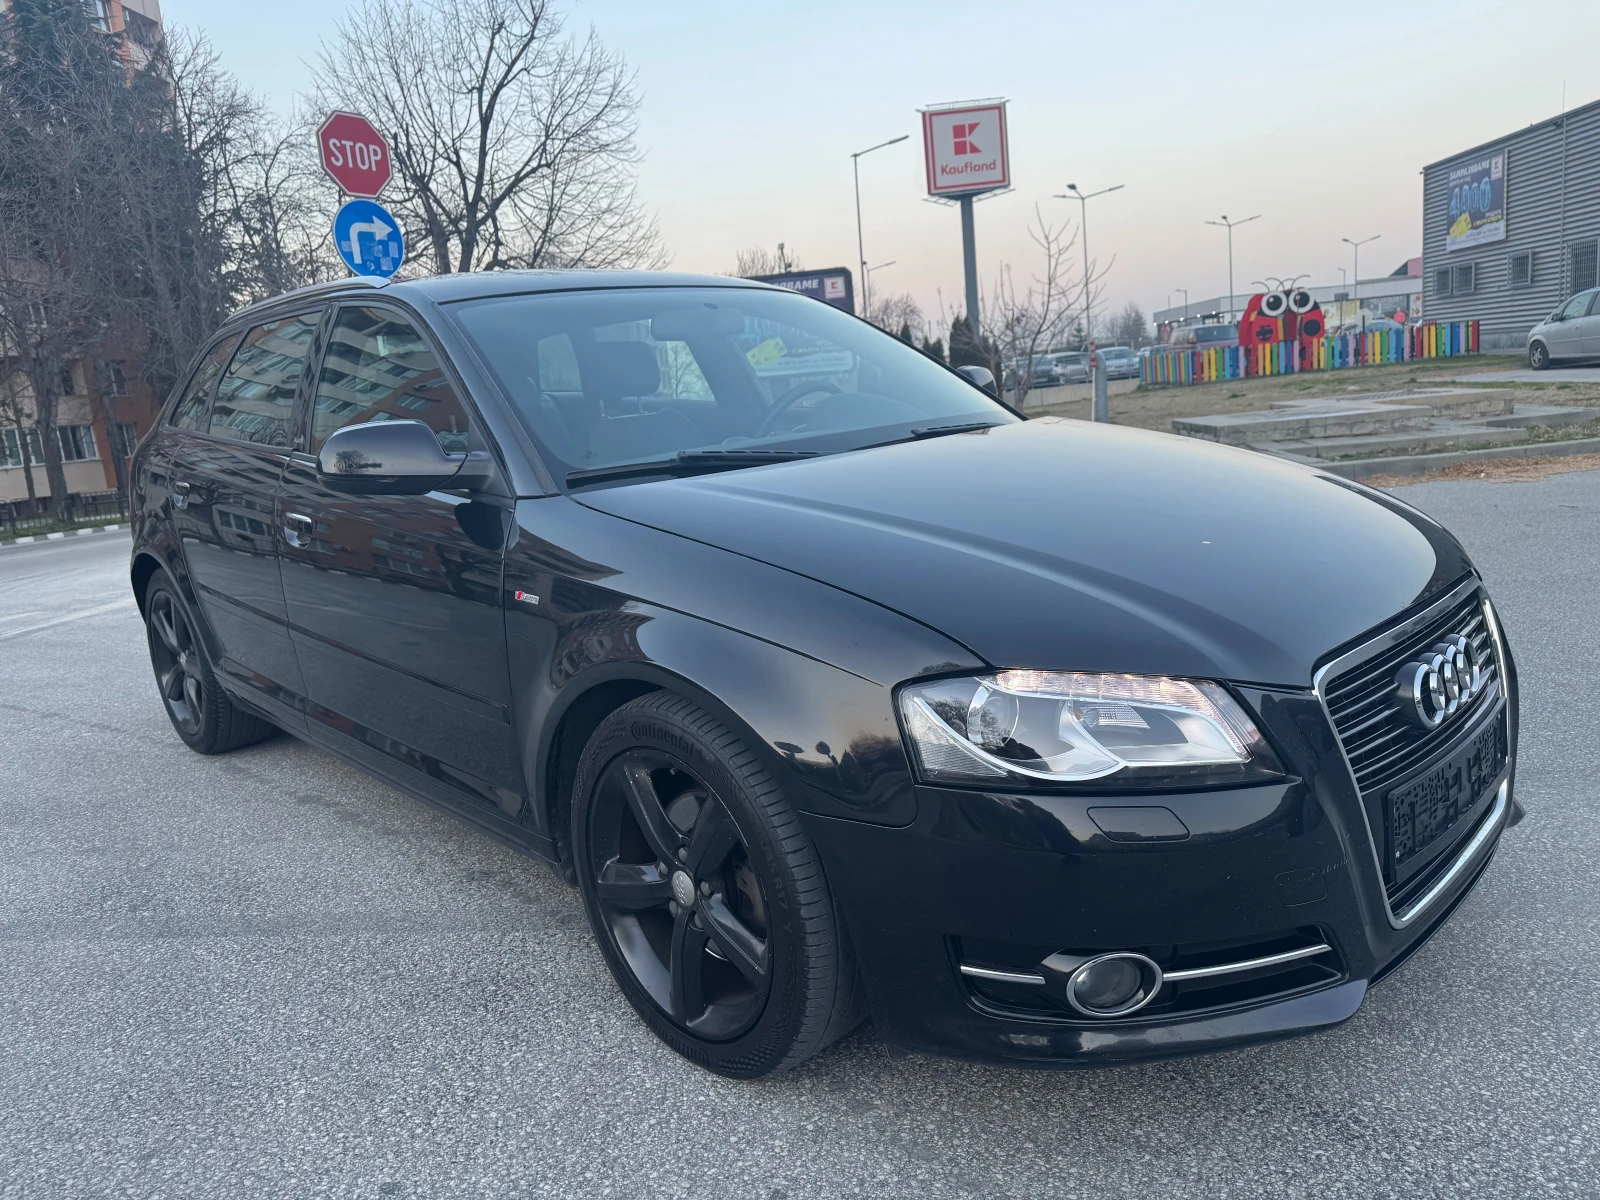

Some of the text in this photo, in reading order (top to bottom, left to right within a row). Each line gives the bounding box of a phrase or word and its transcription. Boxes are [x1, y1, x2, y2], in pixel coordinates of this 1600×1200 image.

[328, 137, 382, 172] STOP
[940, 158, 996, 176] Kaufland
[631, 721, 694, 758] Continental
